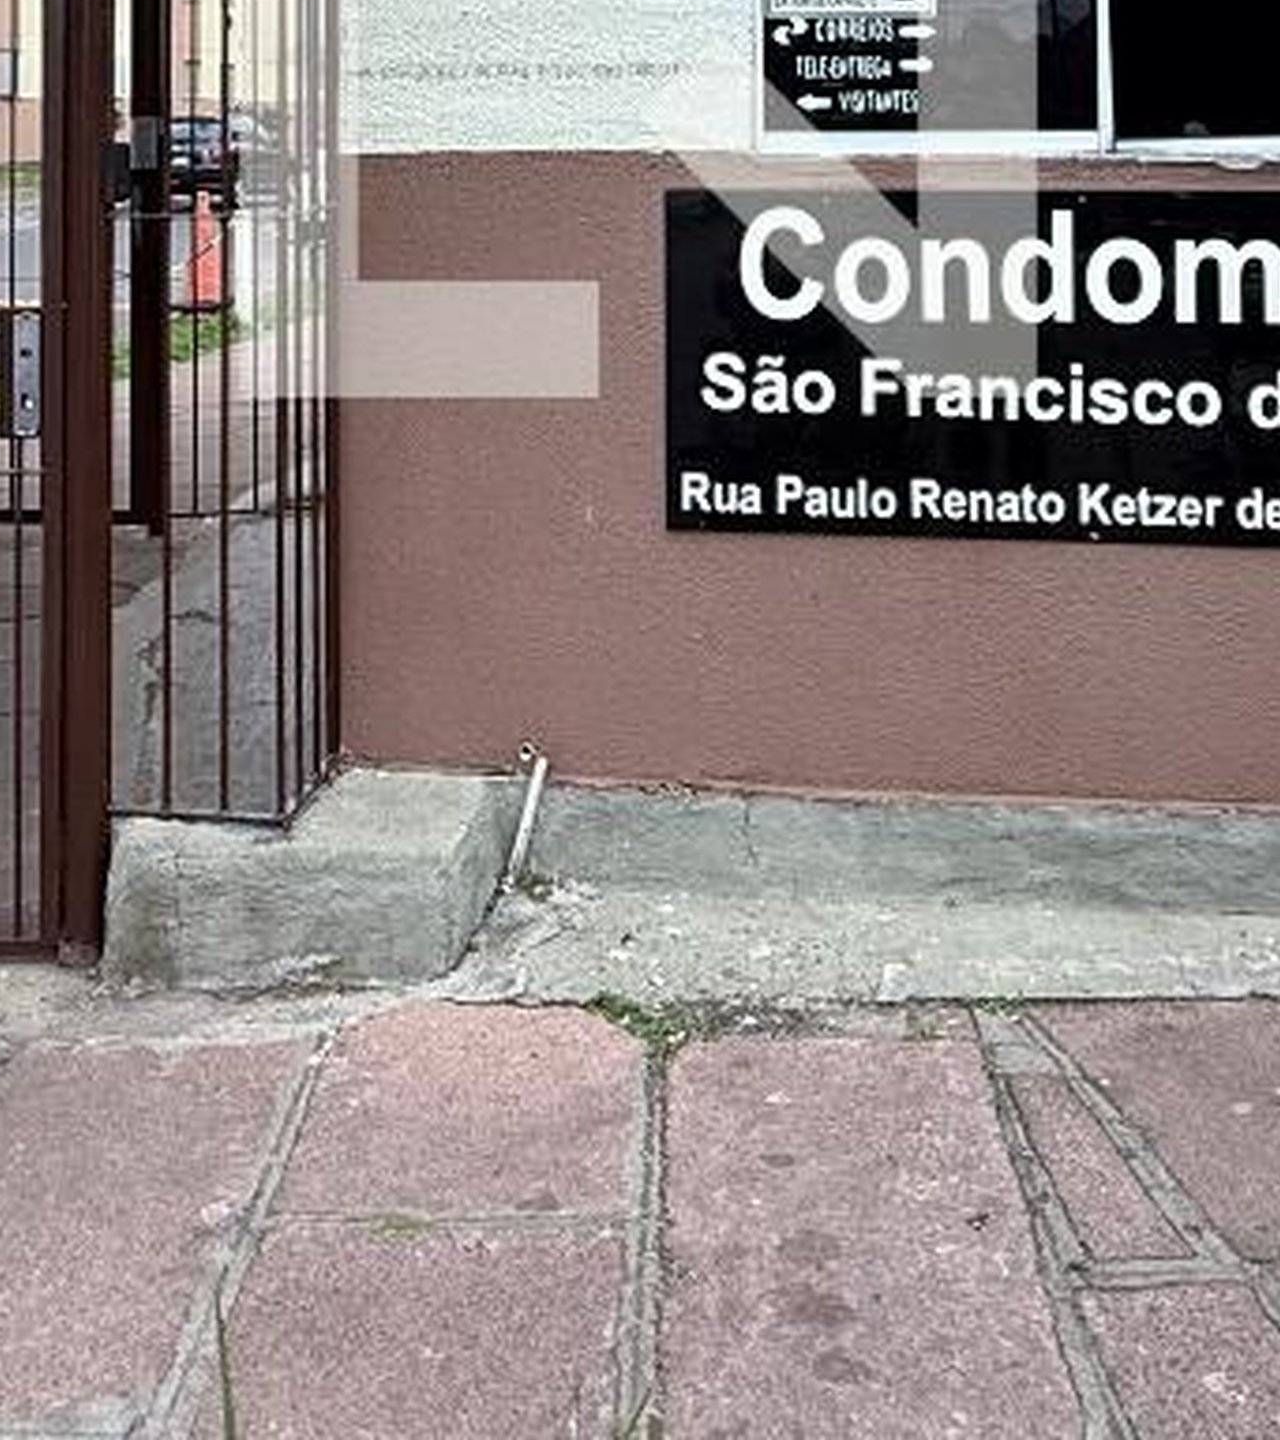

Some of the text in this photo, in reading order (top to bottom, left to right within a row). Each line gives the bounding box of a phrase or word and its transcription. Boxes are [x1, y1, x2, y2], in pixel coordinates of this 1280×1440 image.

[701, 352, 835, 413] São
[862, 357, 1222, 426] Francisco
[682, 472, 761, 514] Rua
[777, 475, 896, 518] Paulo
[911, 479, 1065, 522] Renato
[1079, 483, 1223, 527] Ketzer
